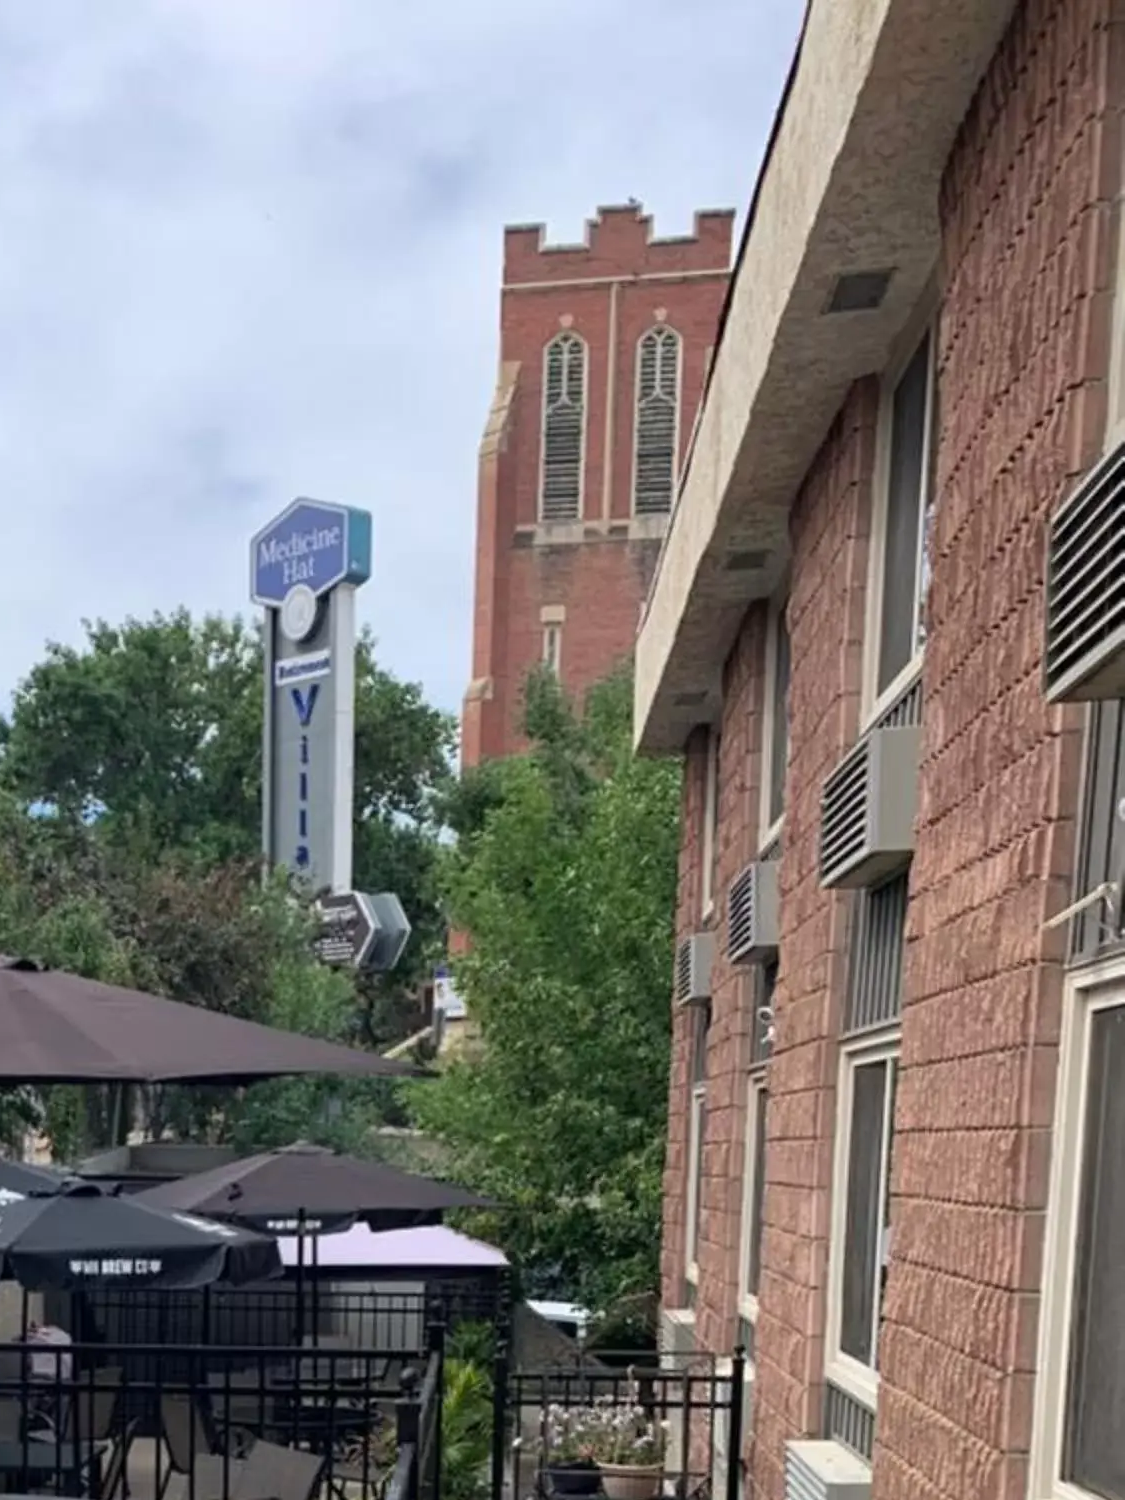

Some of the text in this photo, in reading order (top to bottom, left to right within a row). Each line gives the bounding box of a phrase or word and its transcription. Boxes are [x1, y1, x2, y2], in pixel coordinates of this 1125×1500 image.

[259, 526, 341, 568] Medicine
[283, 556, 315, 585] Hat
[291, 683, 320, 868] Villa
